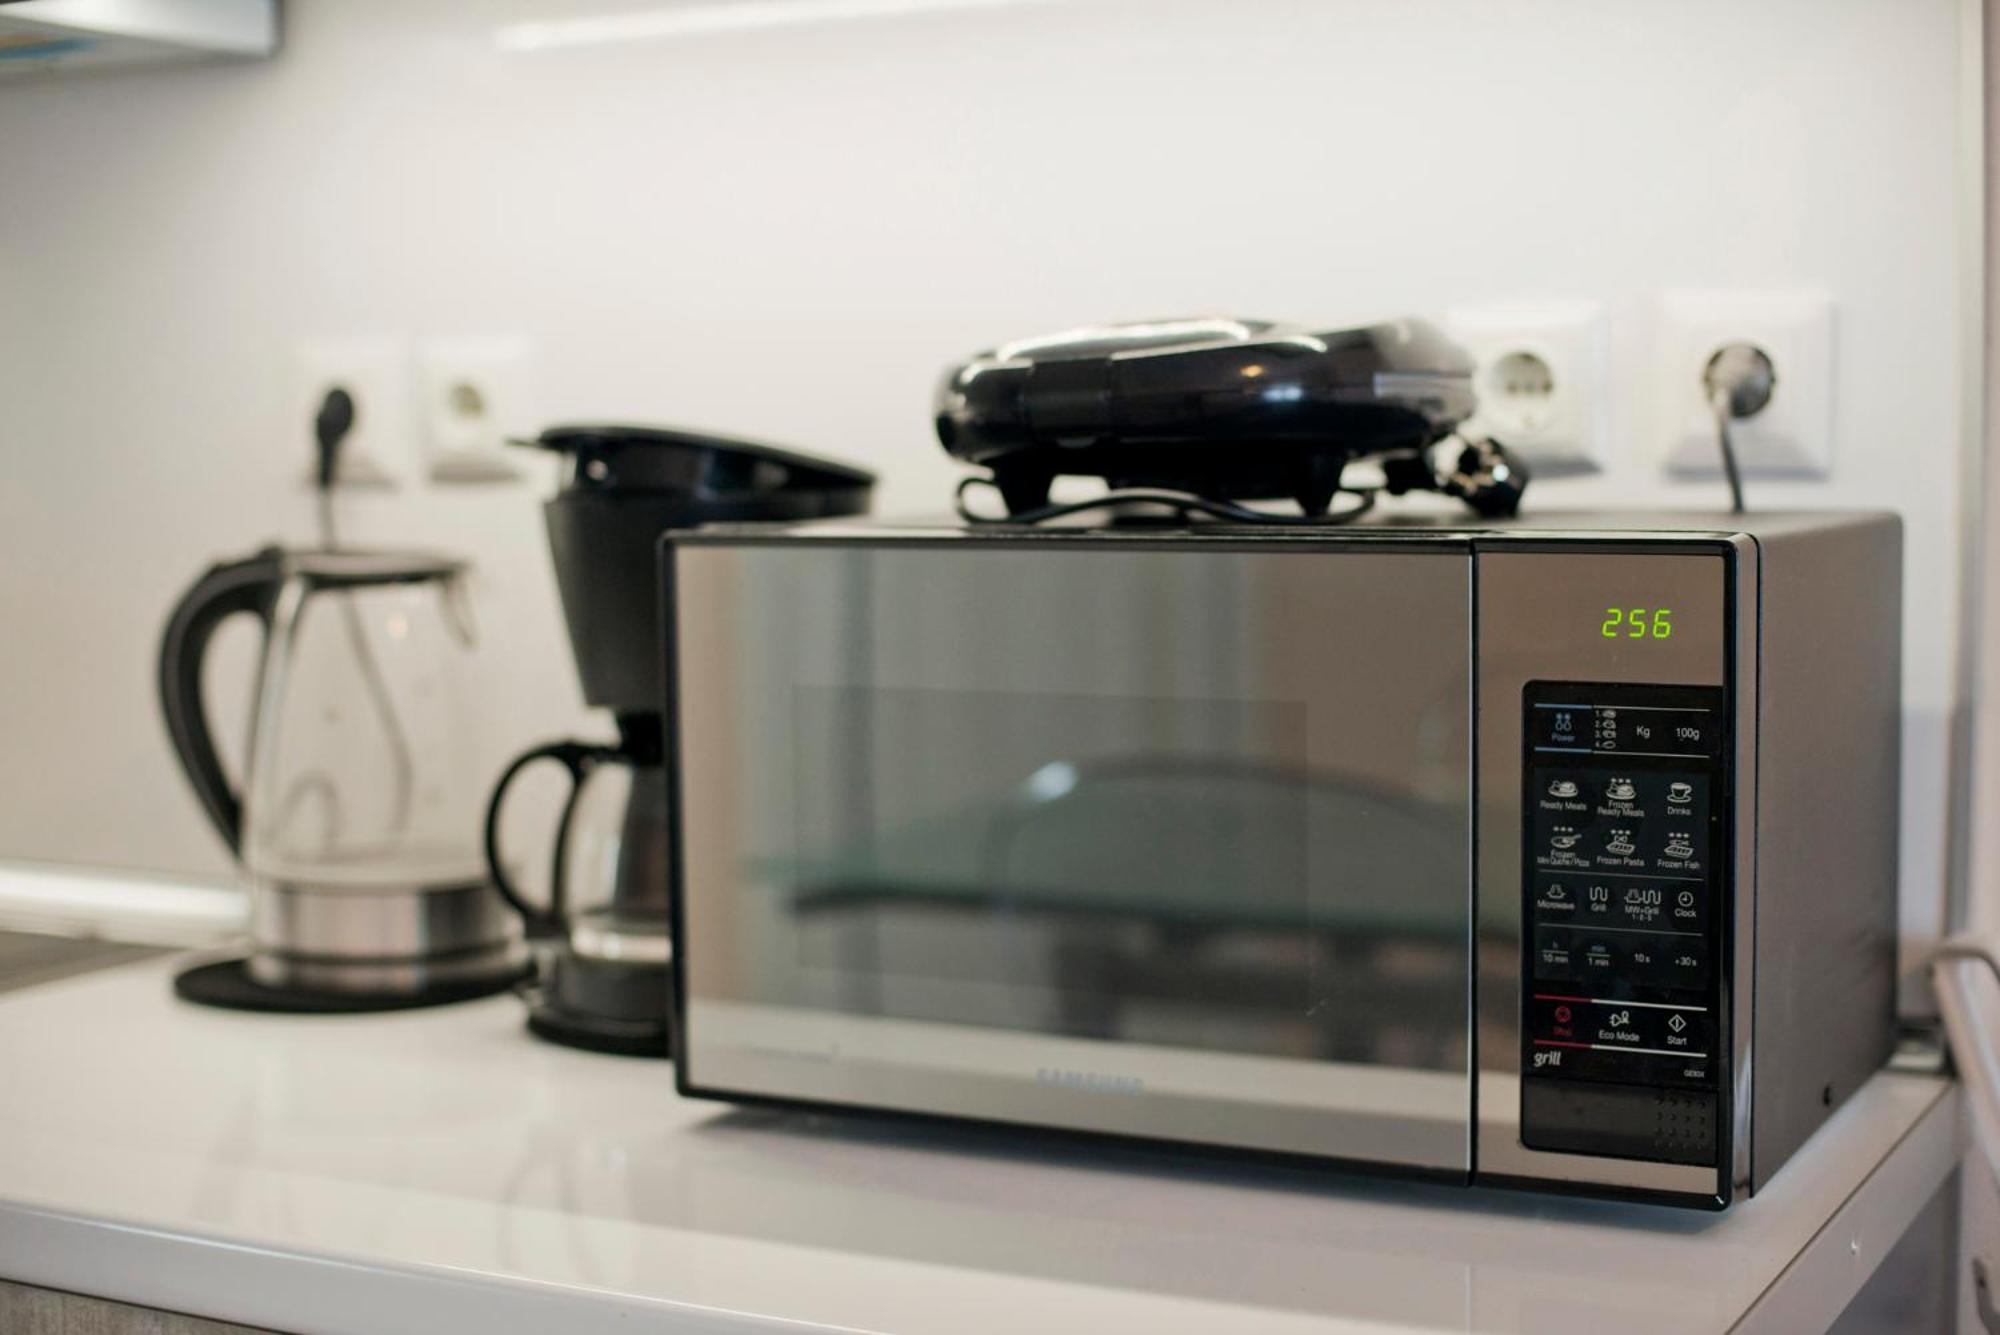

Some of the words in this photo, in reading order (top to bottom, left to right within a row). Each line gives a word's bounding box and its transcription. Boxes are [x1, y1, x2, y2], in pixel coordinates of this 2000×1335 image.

[1601, 608, 1672, 638] 256
[1636, 725, 1650, 739] Kg
[1676, 727, 1700, 741] 100g
[1667, 806, 1691, 815] Drinks
[1674, 908, 1696, 917] Clock
[1598, 1029, 1615, 1040] Eco
[1616, 1031, 1641, 1042] Mode
[1667, 1035, 1688, 1046] Start
[1534, 1051, 1561, 1067] grill
